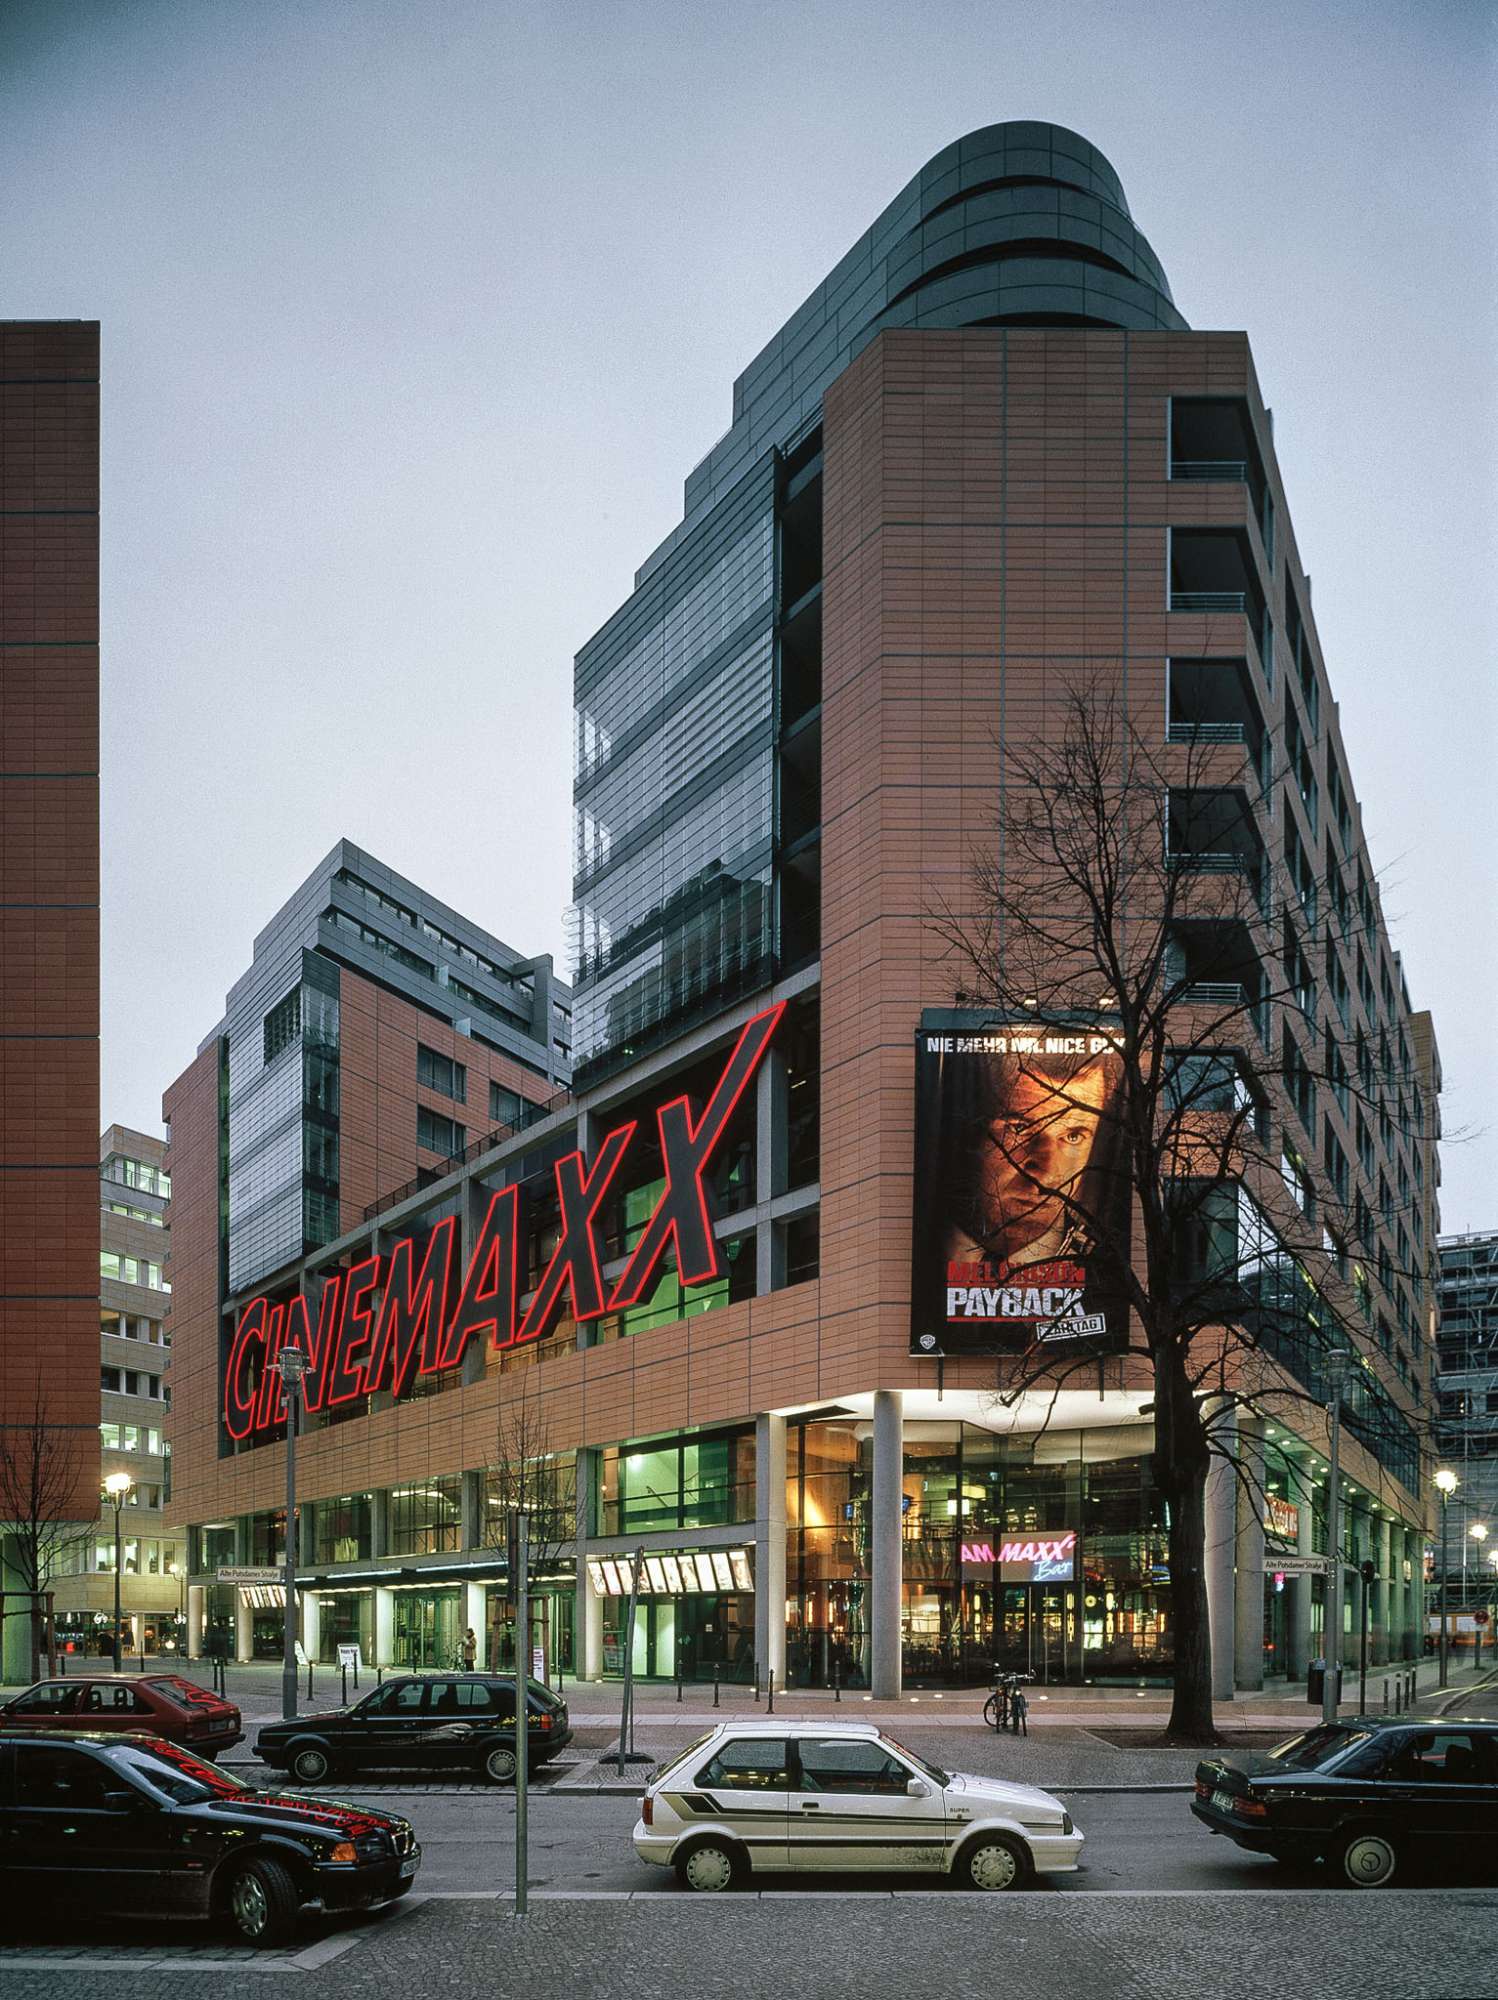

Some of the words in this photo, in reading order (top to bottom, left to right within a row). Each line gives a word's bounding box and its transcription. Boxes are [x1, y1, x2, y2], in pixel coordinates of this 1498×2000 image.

[927, 1037, 953, 1053] NIE
[957, 1037, 1007, 1053] MEHR
[1046, 1037, 1086, 1053] NICE
[224, 1000, 787, 1440] CINEMAXX
[947, 1260, 991, 1282] MEL
[946, 1287, 1086, 1317] PAYBACK
[219, 1569, 232, 1577] Alte
[232, 1569, 261, 1578] Potsdamer
[1033, 1560, 1073, 1582] Bar
[1265, 1560, 1277, 1568] Alte
[1277, 1560, 1304, 1569] Potsdamer
